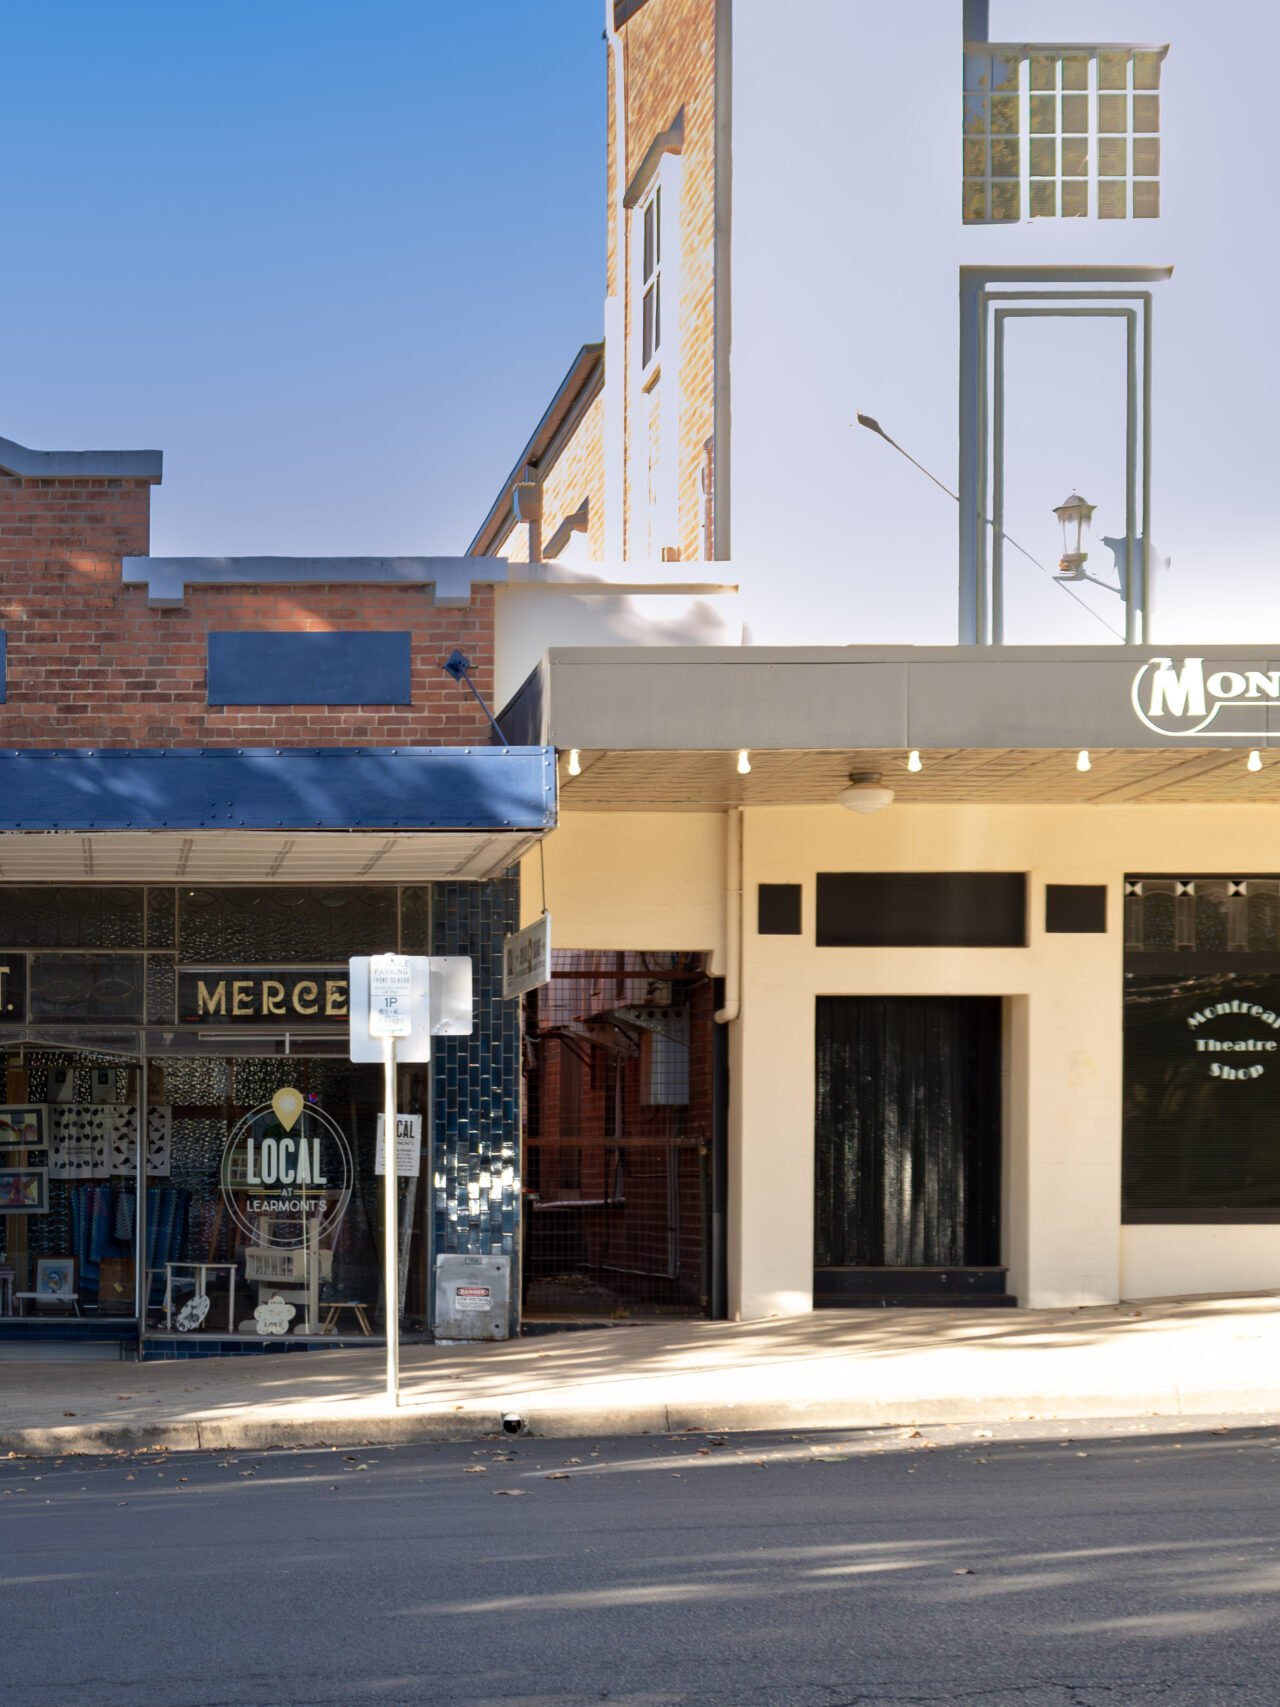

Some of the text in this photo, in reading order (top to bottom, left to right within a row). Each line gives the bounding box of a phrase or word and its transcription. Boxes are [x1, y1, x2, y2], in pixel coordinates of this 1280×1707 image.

[385, 997, 398, 1008] 1P
[1194, 1039, 1278, 1051] Theatre
[1208, 1062, 1265, 1080] Shop
[247, 1137, 328, 1184] LOCAL
[281, 1187, 293, 1197] AT
